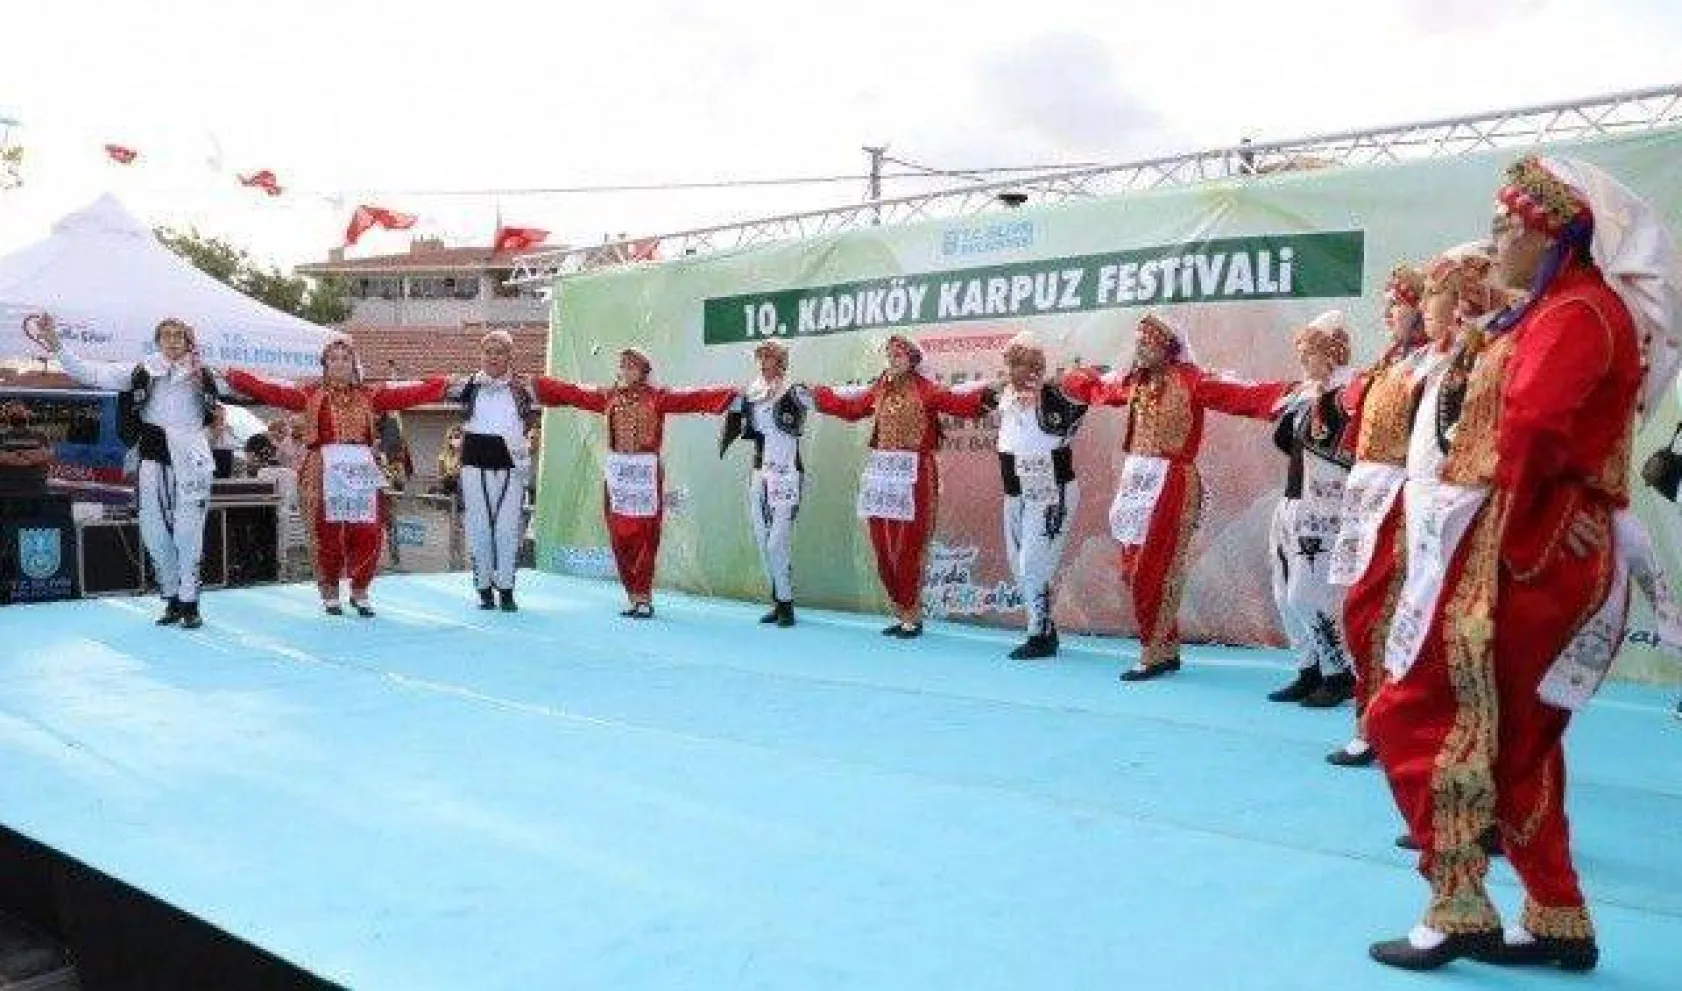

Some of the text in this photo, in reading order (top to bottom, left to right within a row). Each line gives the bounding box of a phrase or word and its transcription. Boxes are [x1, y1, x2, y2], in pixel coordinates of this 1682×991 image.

[743, 302, 788, 337] 10.
[799, 278, 928, 332] KADIKÖY
[937, 267, 1084, 319] KARPUZ
